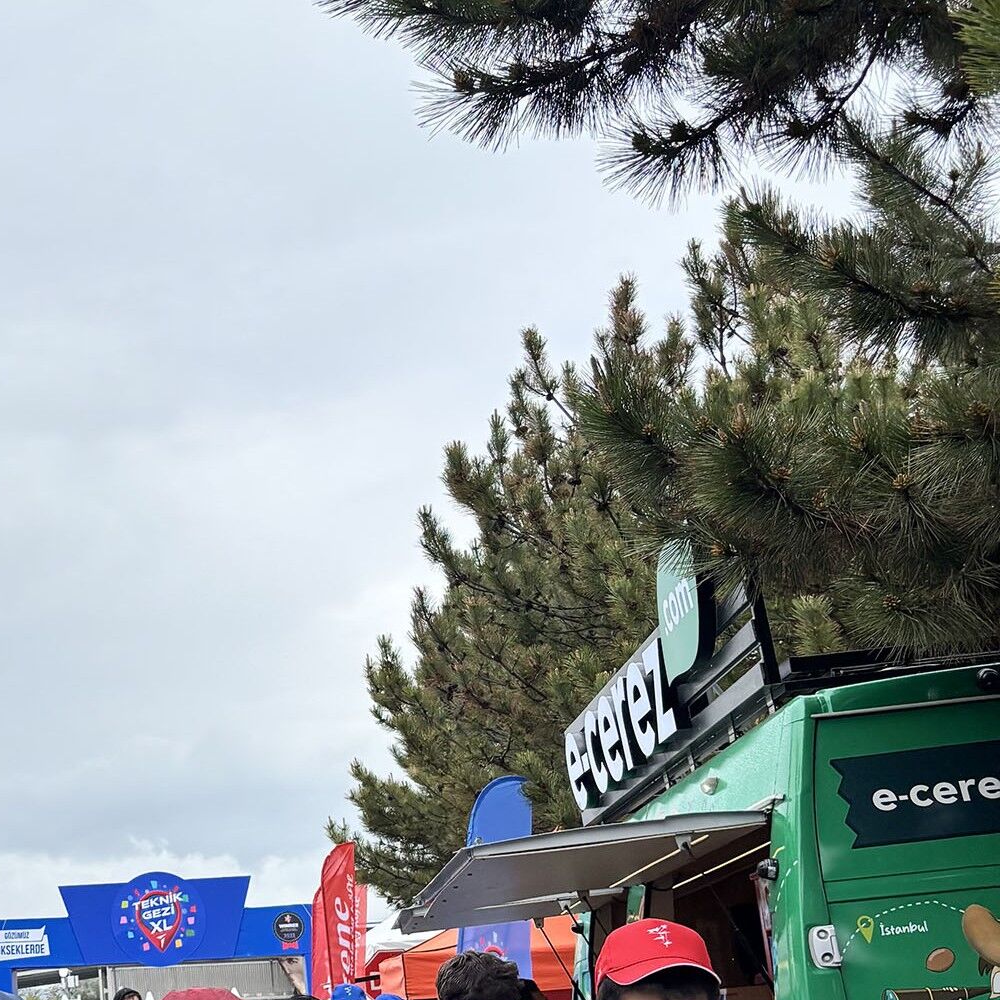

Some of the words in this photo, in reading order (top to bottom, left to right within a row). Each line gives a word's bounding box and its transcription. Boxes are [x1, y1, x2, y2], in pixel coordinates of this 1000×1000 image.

[565, 638, 677, 811] e-cerez
[872, 776, 1000, 811] e-cere
[132, 890, 184, 911] TEKNİK
[142, 903, 175, 920] GEZİ
[149, 919, 173, 935] XL
[879, 920, 929, 937] İstanbul
